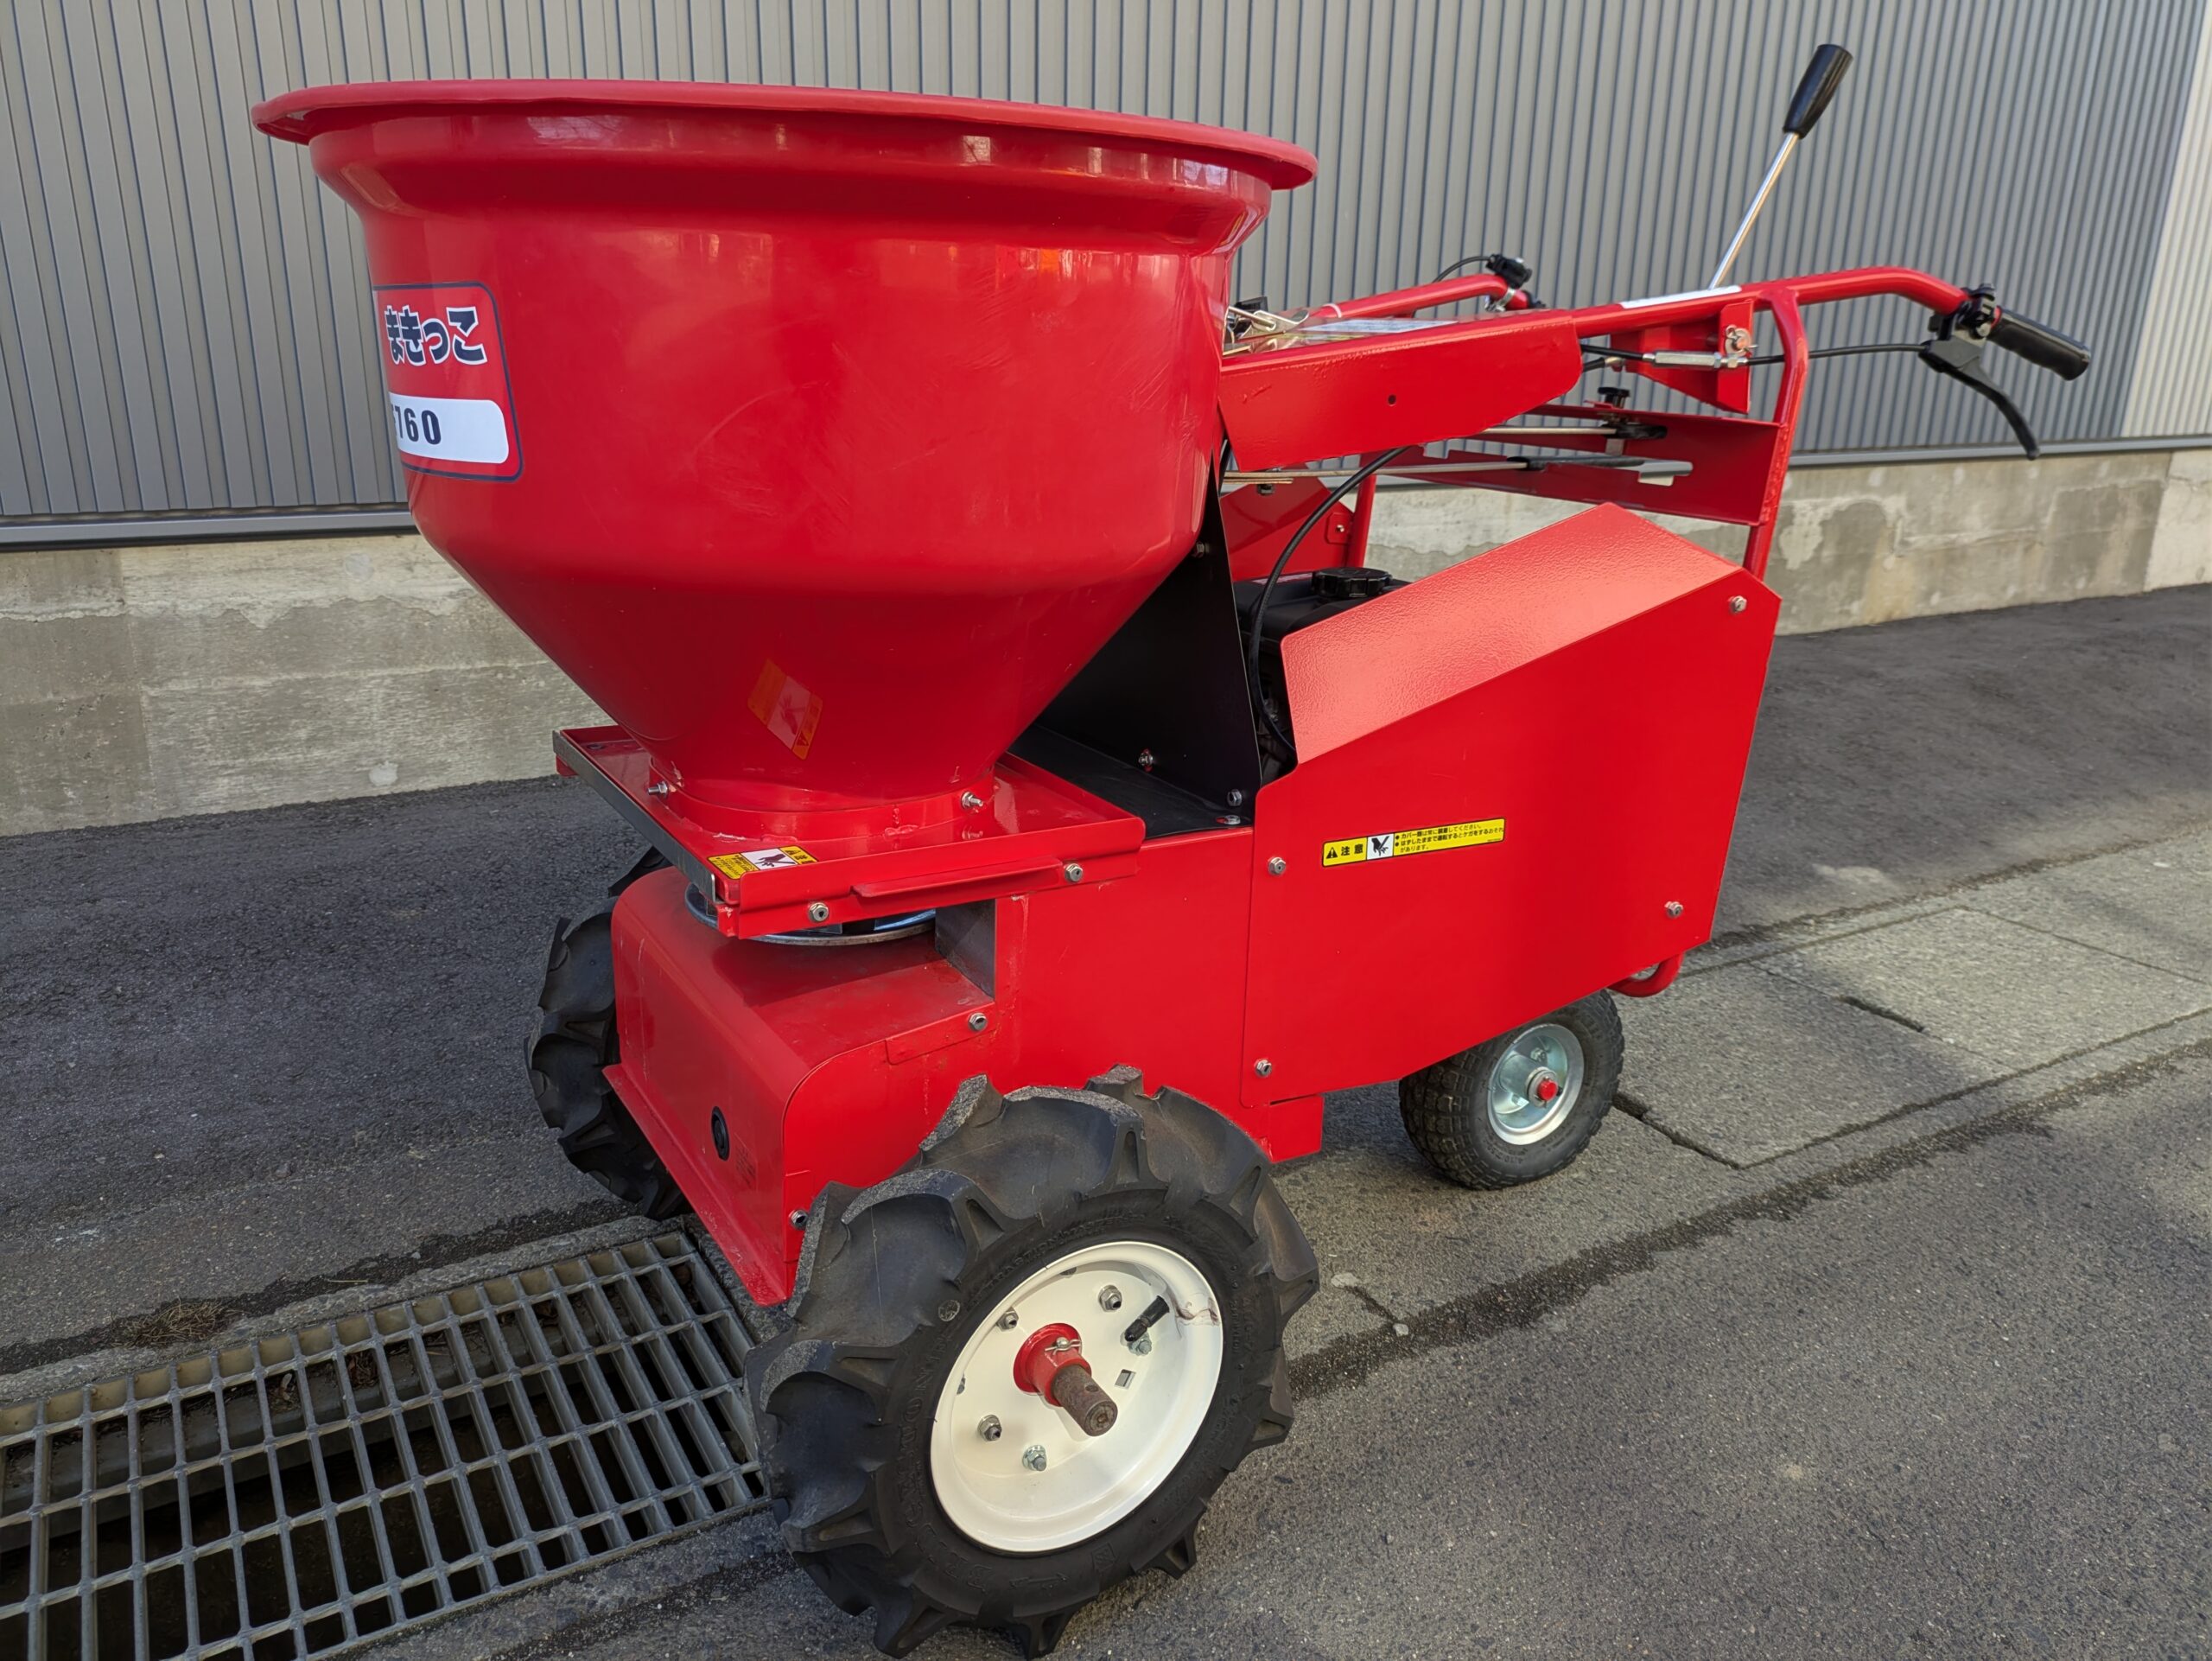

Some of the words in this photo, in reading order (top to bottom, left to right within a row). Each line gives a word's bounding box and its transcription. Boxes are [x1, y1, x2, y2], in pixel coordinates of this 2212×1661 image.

[385, 305, 487, 366] まきっこ
[391, 404, 442, 445] 760
[1341, 843, 1363, 856] 注意
